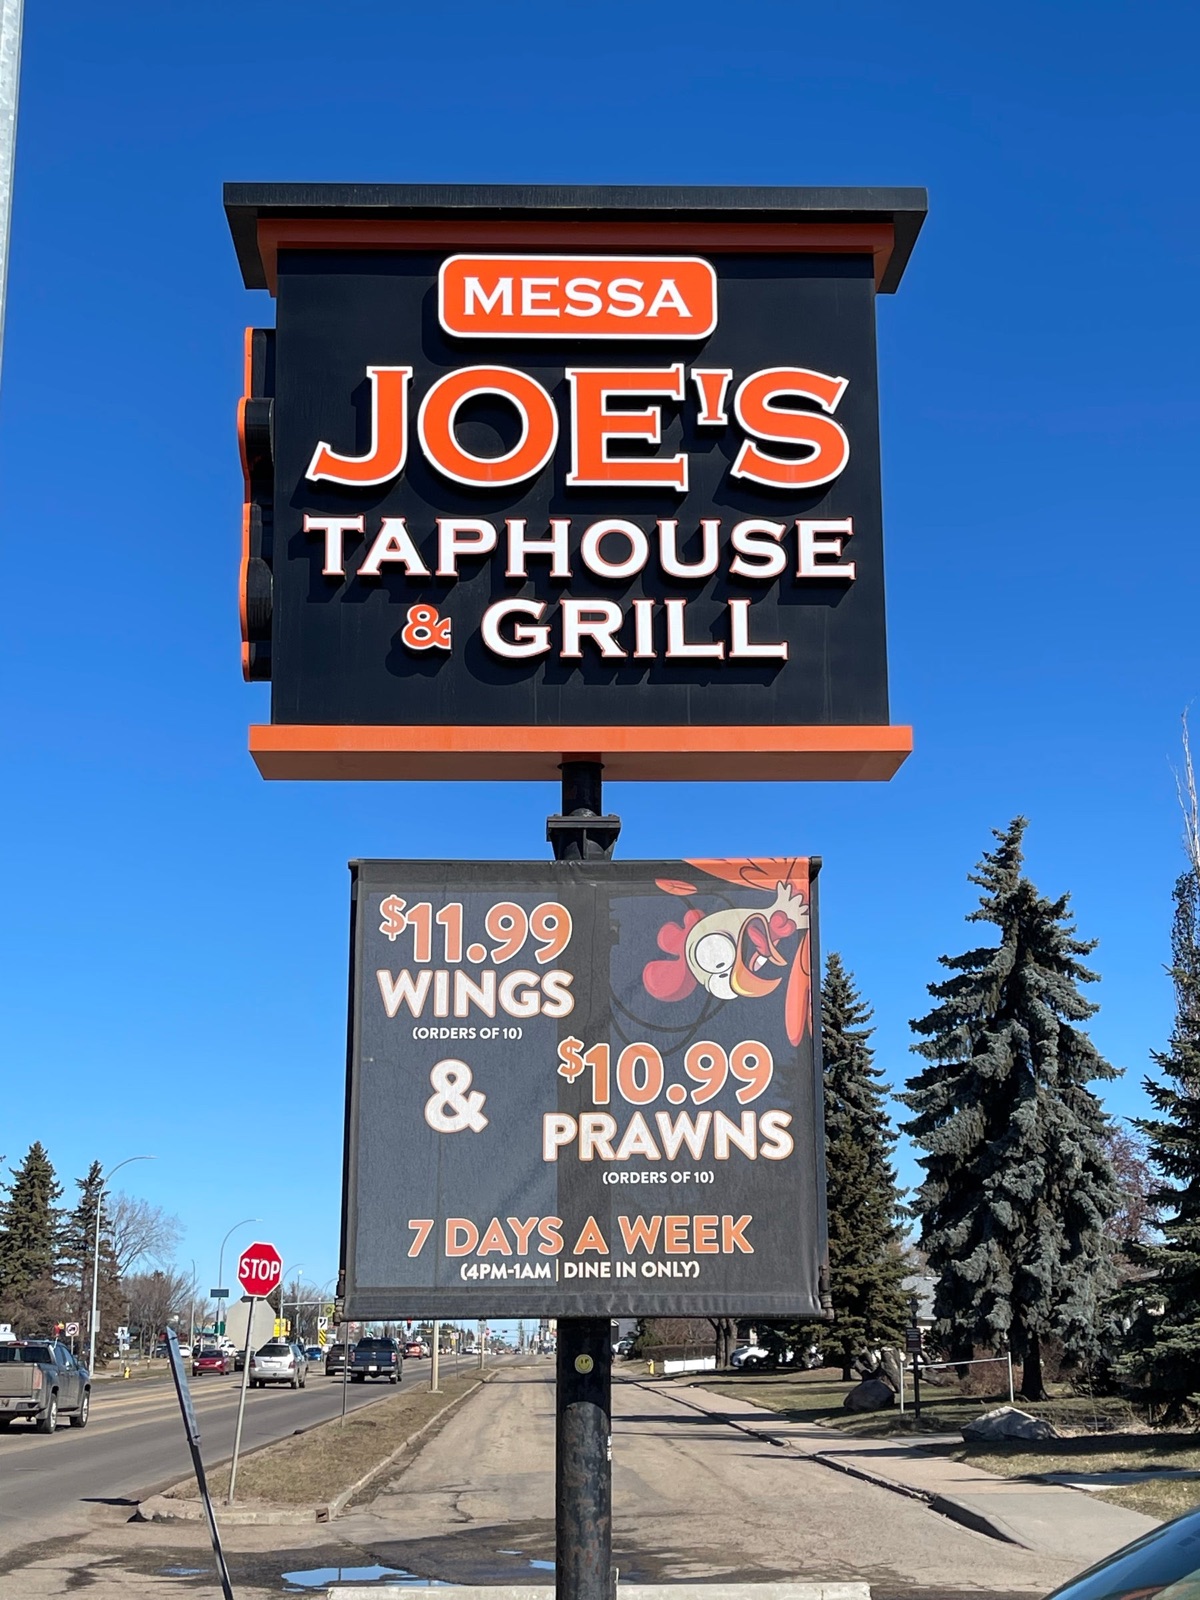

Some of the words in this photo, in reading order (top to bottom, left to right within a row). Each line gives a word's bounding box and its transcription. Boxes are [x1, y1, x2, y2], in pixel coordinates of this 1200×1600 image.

[463, 277, 693, 318] MESSA
[305, 363, 850, 492] JOE'S
[303, 514, 857, 580] TAPHOUSE
[401, 604, 452, 651] &
[481, 598, 789, 660] GRILL
[379, 895, 573, 964] $11.99
[376, 969, 575, 1019] WINGS
[412, 1027, 477, 1040] (ORDERS
[479, 1027, 500, 1040] OF
[502, 1027, 523, 1040] 10)
[424, 1058, 489, 1134] &
[557, 1036, 774, 1106] $10.99
[542, 1110, 795, 1162] PRAWNS
[602, 1171, 668, 1185] (ORDERS
[670, 1171, 691, 1184] OF
[693, 1171, 715, 1184] 10)
[407, 1219, 435, 1258] 7
[445, 1216, 564, 1258] DAYS
[573, 1215, 609, 1255] A
[617, 1215, 754, 1254] WEEK
[239, 1257, 280, 1281] STOP
[564, 1261, 611, 1278] DINE
[616, 1261, 637, 1278] IN
[641, 1260, 700, 1279] ONLY)
